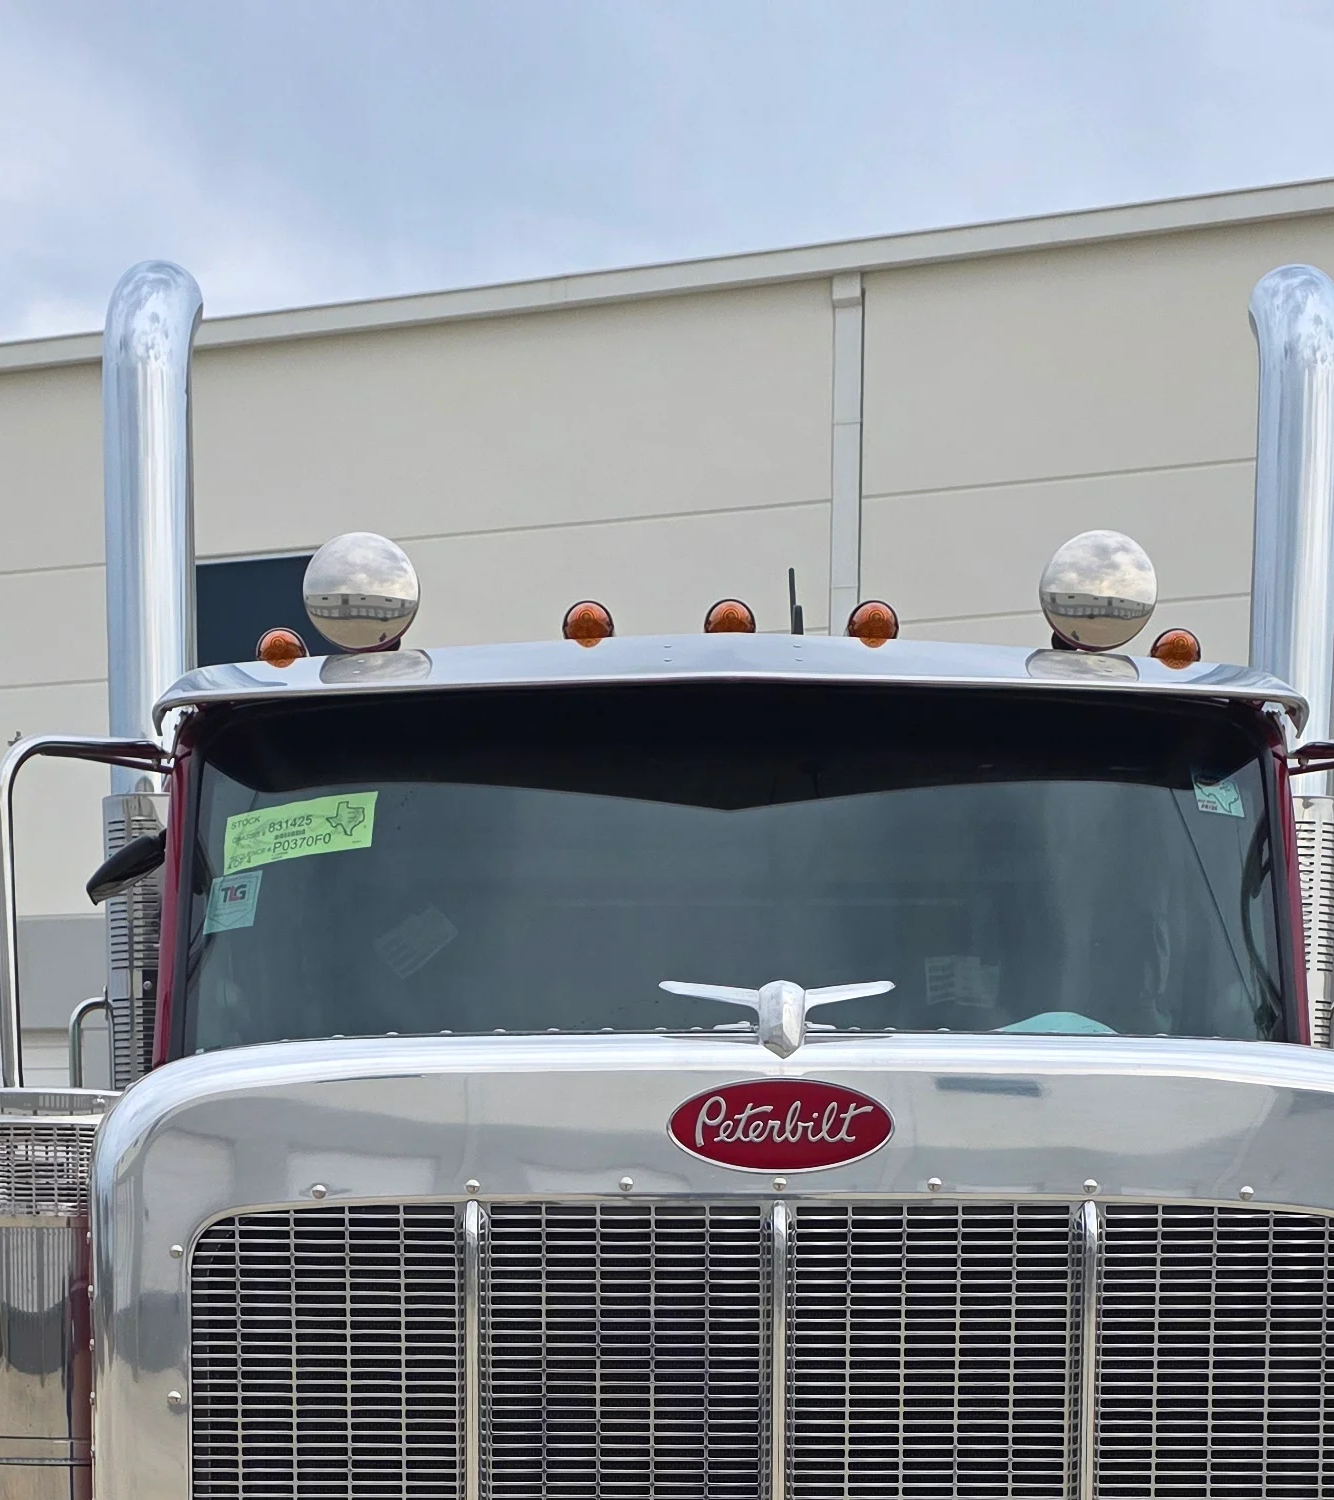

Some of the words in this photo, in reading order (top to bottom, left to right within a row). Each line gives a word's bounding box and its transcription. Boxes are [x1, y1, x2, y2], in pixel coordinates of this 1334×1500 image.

[231, 816, 261, 829] STOCK
[268, 814, 313, 833] 831425
[272, 833, 332, 853] P0370F0
[221, 884, 247, 903] TLG
[695, 1096, 874, 1147] Peterbilt
